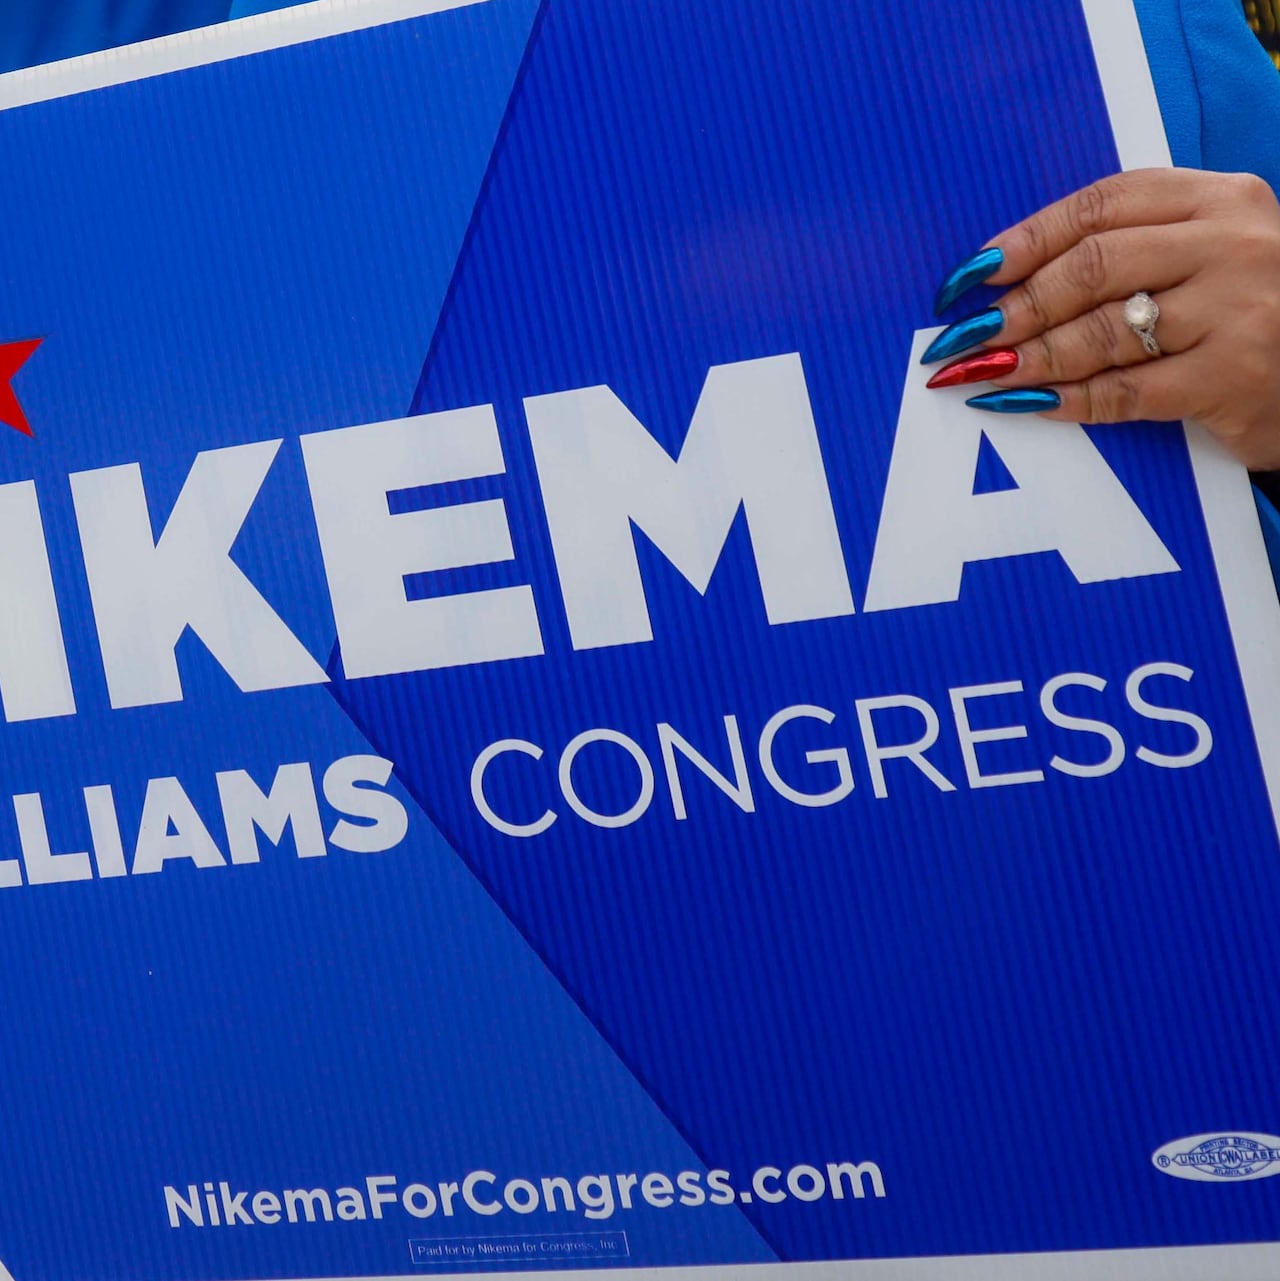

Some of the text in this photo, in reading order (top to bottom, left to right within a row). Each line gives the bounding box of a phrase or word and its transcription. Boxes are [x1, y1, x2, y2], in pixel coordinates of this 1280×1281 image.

[470, 661, 1214, 838] CONGRESS
[1180, 1153, 1216, 1165] UNION
[163, 1160, 886, 1228] NikemaForCongress.com
[418, 1245, 442, 1256] Paid
[445, 1244, 459, 1255] for
[462, 1243, 475, 1257] by
[478, 1242, 520, 1255] Nikema
[523, 1241, 537, 1252] for
